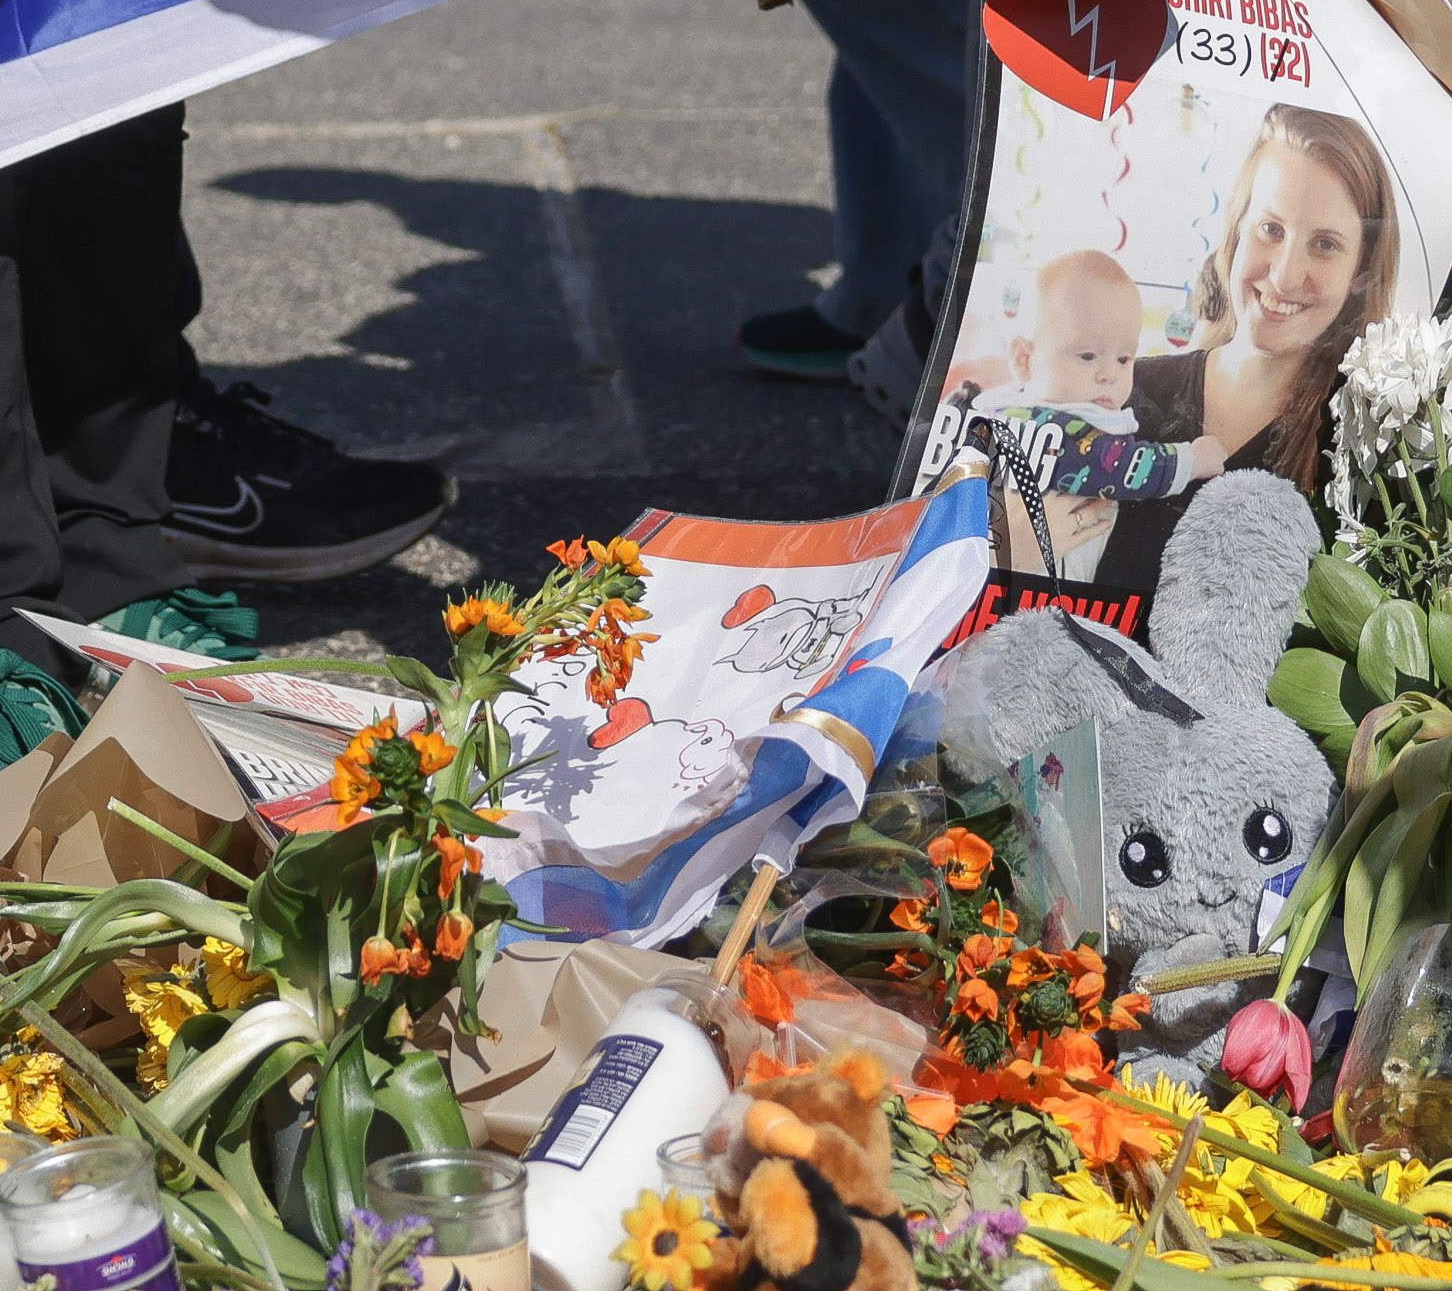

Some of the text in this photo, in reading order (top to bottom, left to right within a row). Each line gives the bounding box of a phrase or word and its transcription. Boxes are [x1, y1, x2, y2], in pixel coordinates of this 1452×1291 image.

[1175, 20, 1253, 78] (33)
[919, 402, 1065, 494] BNG
[283, 688, 365, 716] BIBAS
